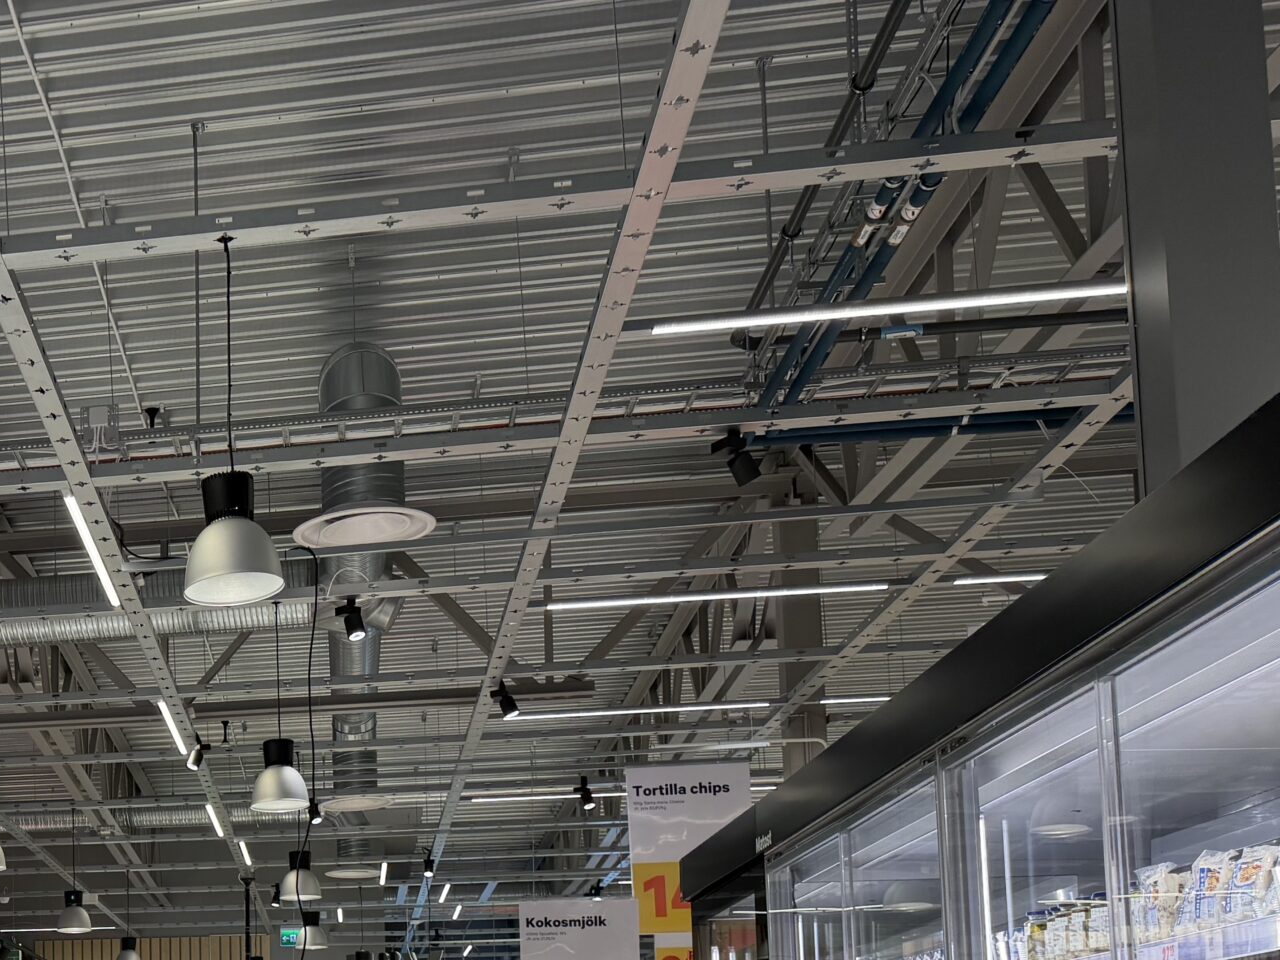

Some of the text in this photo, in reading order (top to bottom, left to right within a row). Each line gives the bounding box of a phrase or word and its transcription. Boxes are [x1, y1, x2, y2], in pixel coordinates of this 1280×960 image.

[631, 781, 731, 797] Tortilla chips
[525, 916, 607, 930] Kokosmjölk
